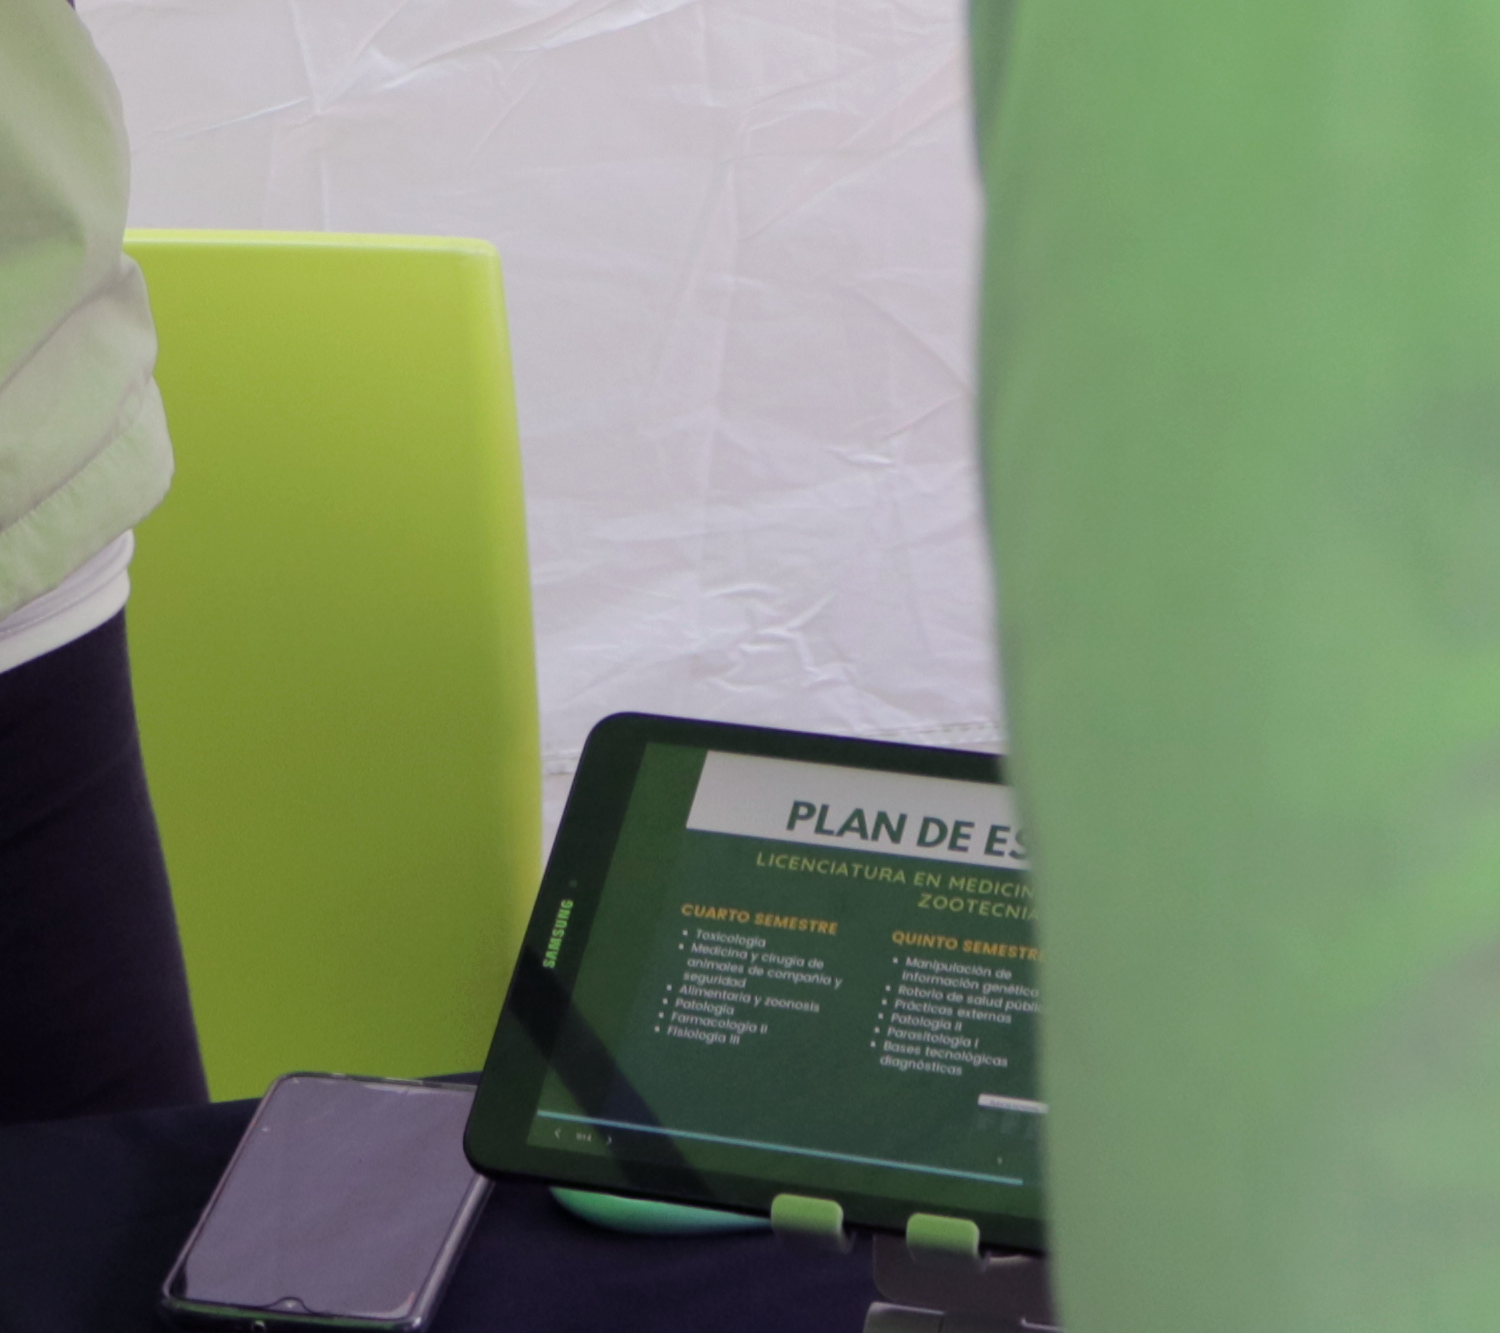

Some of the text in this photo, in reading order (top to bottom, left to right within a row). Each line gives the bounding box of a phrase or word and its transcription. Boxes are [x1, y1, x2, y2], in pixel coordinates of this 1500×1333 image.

[786, 800, 907, 844] PLAN
[916, 817, 975, 853] DE
[756, 852, 906, 884] LICENCIATURA
[914, 872, 942, 888] EN
[681, 903, 838, 936] CUARTO SEMESTRE
[542, 899, 574, 969] SAMSUNG
[891, 930, 958, 950] QUINTO
[691, 943, 748, 960] Medicina
[750, 951, 760, 963] y
[807, 957, 824, 970] de
[905, 956, 1012, 980] Manipulación de
[683, 971, 747, 989] seguridad
[687, 957, 744, 974] animales
[748, 964, 764, 976] de
[833, 978, 843, 990] y
[679, 984, 820, 1013] Alimentaria y zoonosis
[946, 992, 964, 1003] de
[966, 994, 1003, 1009] salud
[982, 983, 1039, 999] genética
[894, 998, 1012, 1025] Prácticas externas
[729, 1035, 740, 1045] III
[760, 1024, 768, 1034] II
[880, 1054, 963, 1076] diagnósticas
[883, 1040, 1008, 1068] Bases tecnológicas
